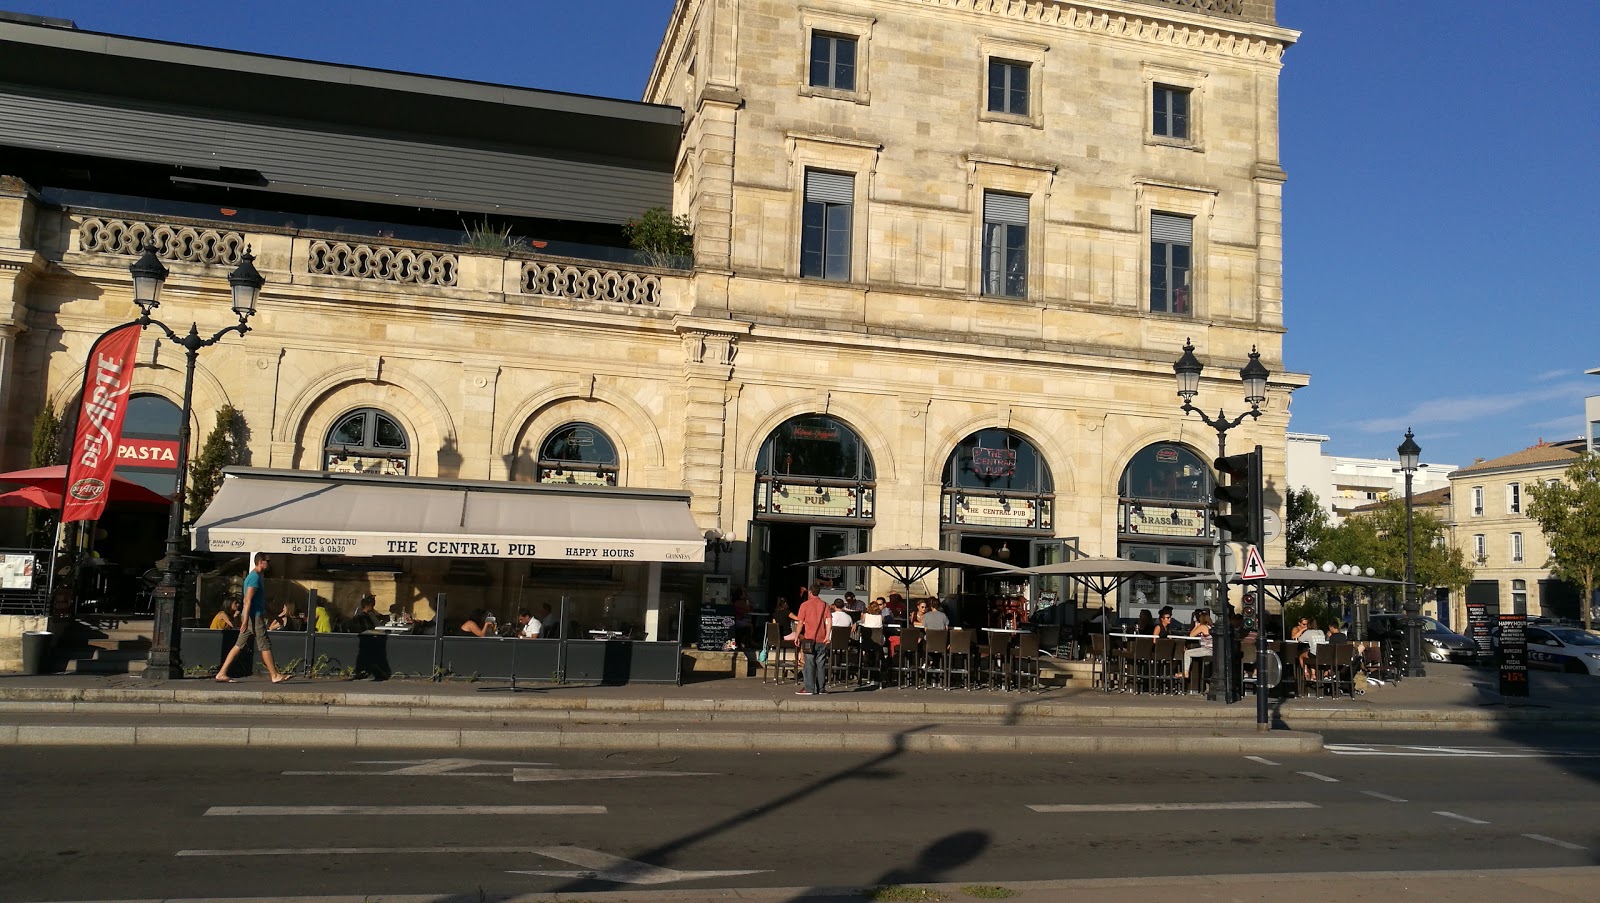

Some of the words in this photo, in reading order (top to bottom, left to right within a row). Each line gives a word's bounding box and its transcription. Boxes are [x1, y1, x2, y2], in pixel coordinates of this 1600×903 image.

[85, 352, 130, 460] ARTE
[81, 434, 104, 469] DEL
[117, 445, 175, 461] PASTA
[985, 466, 1003, 474] PUB
[804, 496, 826, 505] PUB
[982, 508, 1011, 516] CENTRAL
[1141, 516, 1194, 526] BRASSERIE
[281, 537, 316, 545] SERVICE
[387, 541, 418, 553] THE
[427, 541, 500, 555] CENTRAL
[508, 543, 536, 556] PUB
[565, 548, 598, 557] HAPPY
[602, 549, 635, 558] HOURS
